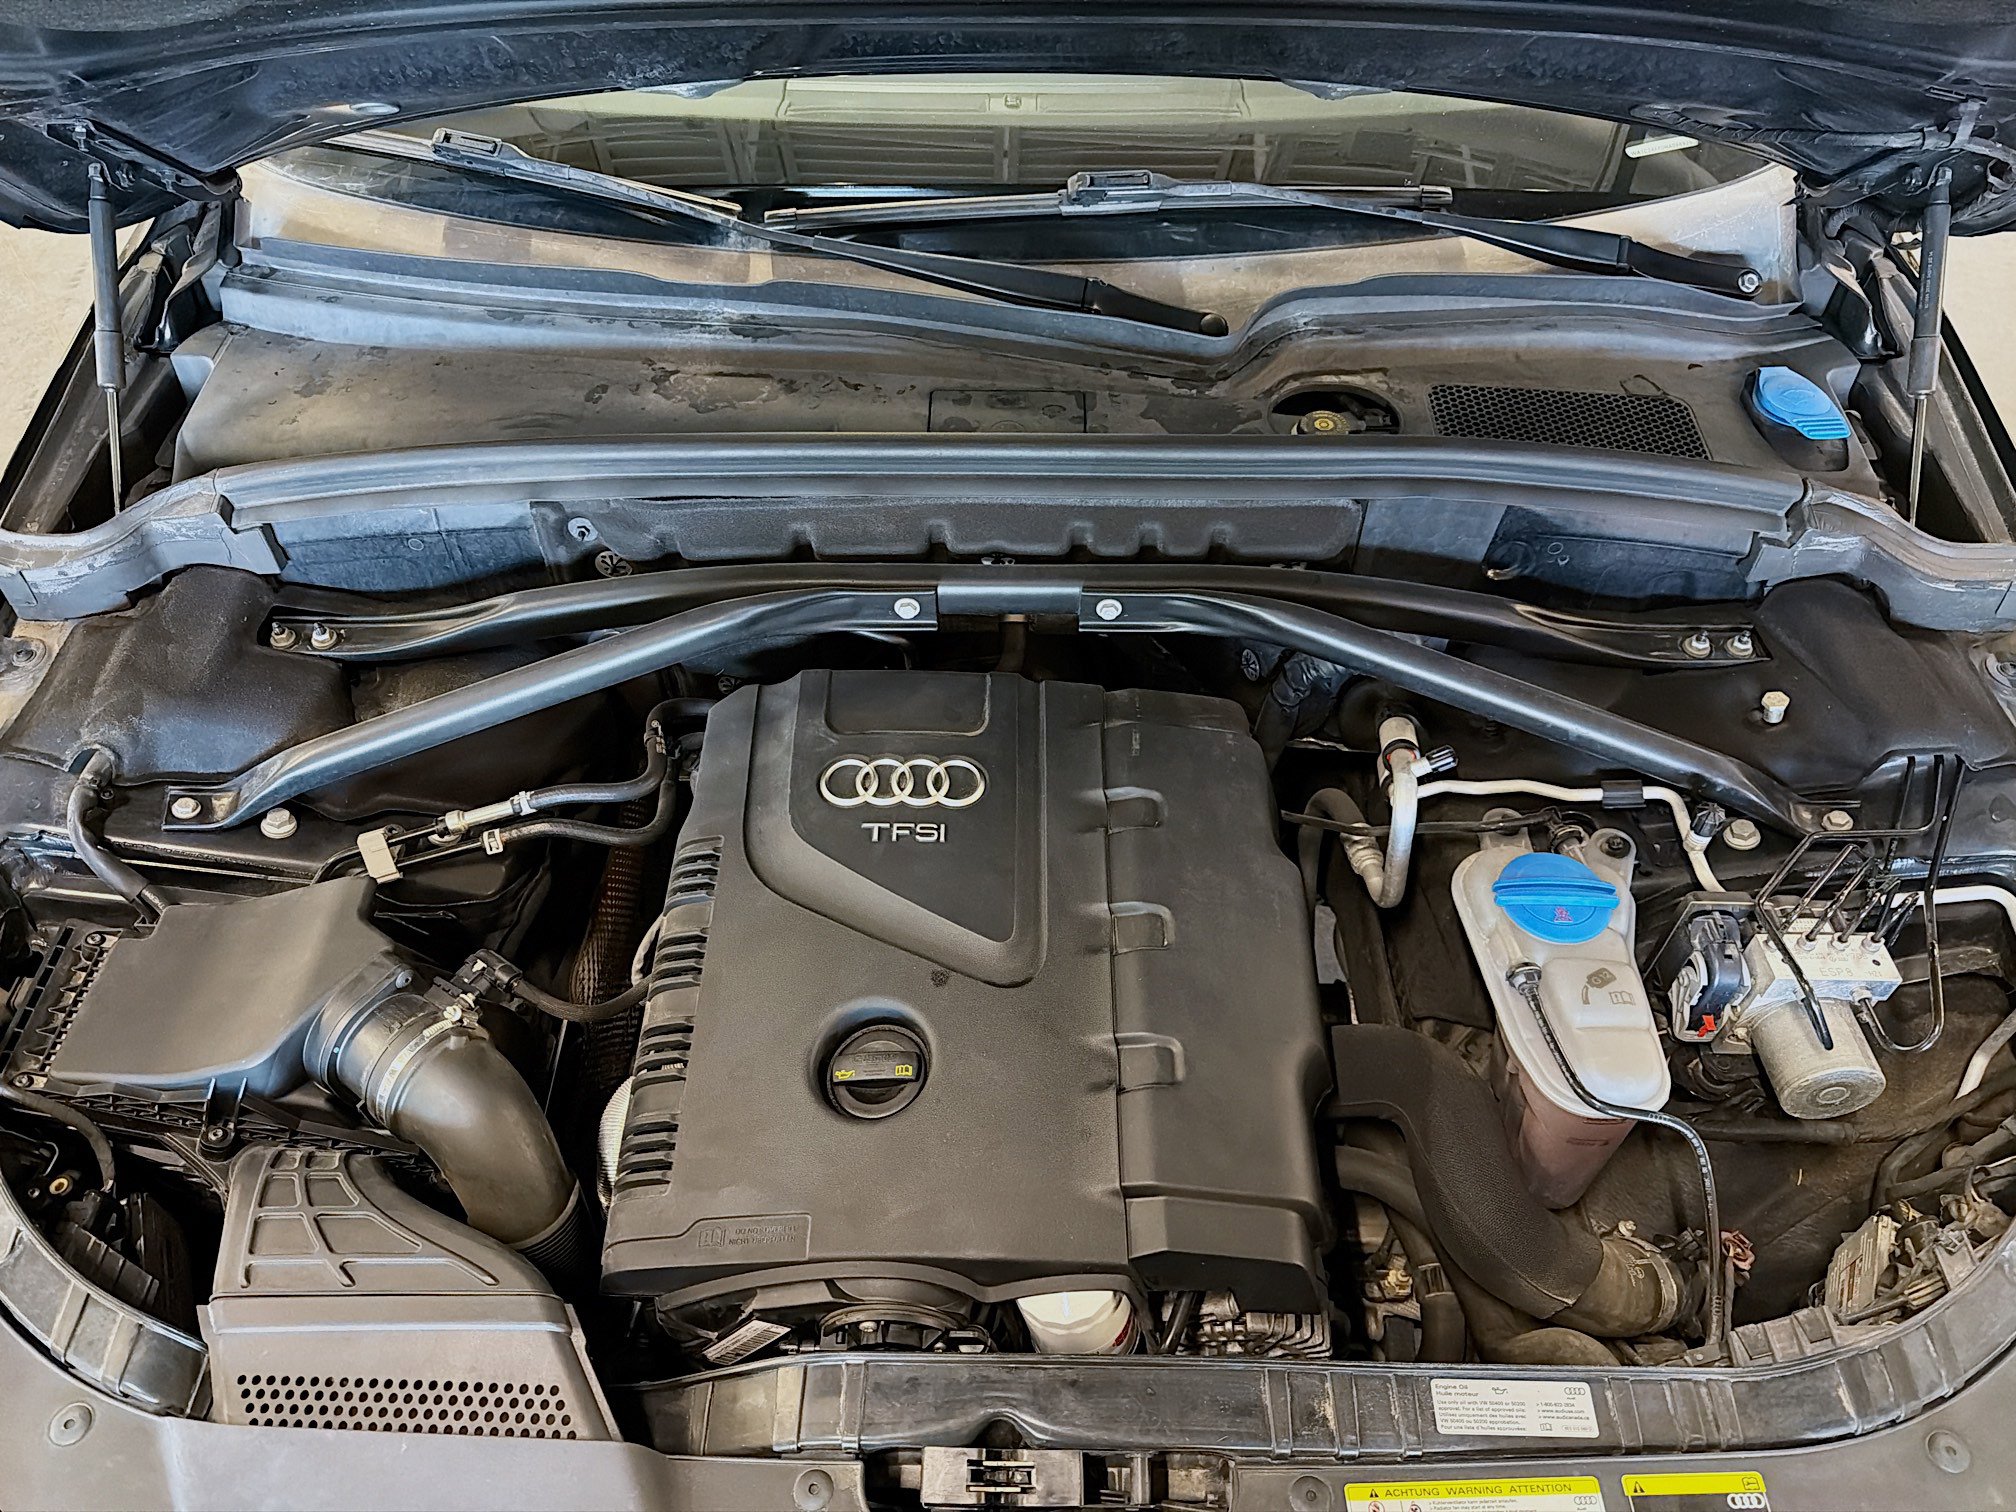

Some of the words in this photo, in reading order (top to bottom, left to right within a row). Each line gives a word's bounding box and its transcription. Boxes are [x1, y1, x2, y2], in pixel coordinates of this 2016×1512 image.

[861, 822, 946, 843] TFSI
[1819, 968, 1844, 976] ESP
[1384, 1487, 1440, 1498] ACHTUNG
[1446, 1485, 1503, 1496] WARNING
[1509, 1483, 1573, 1494] ATTENTION
